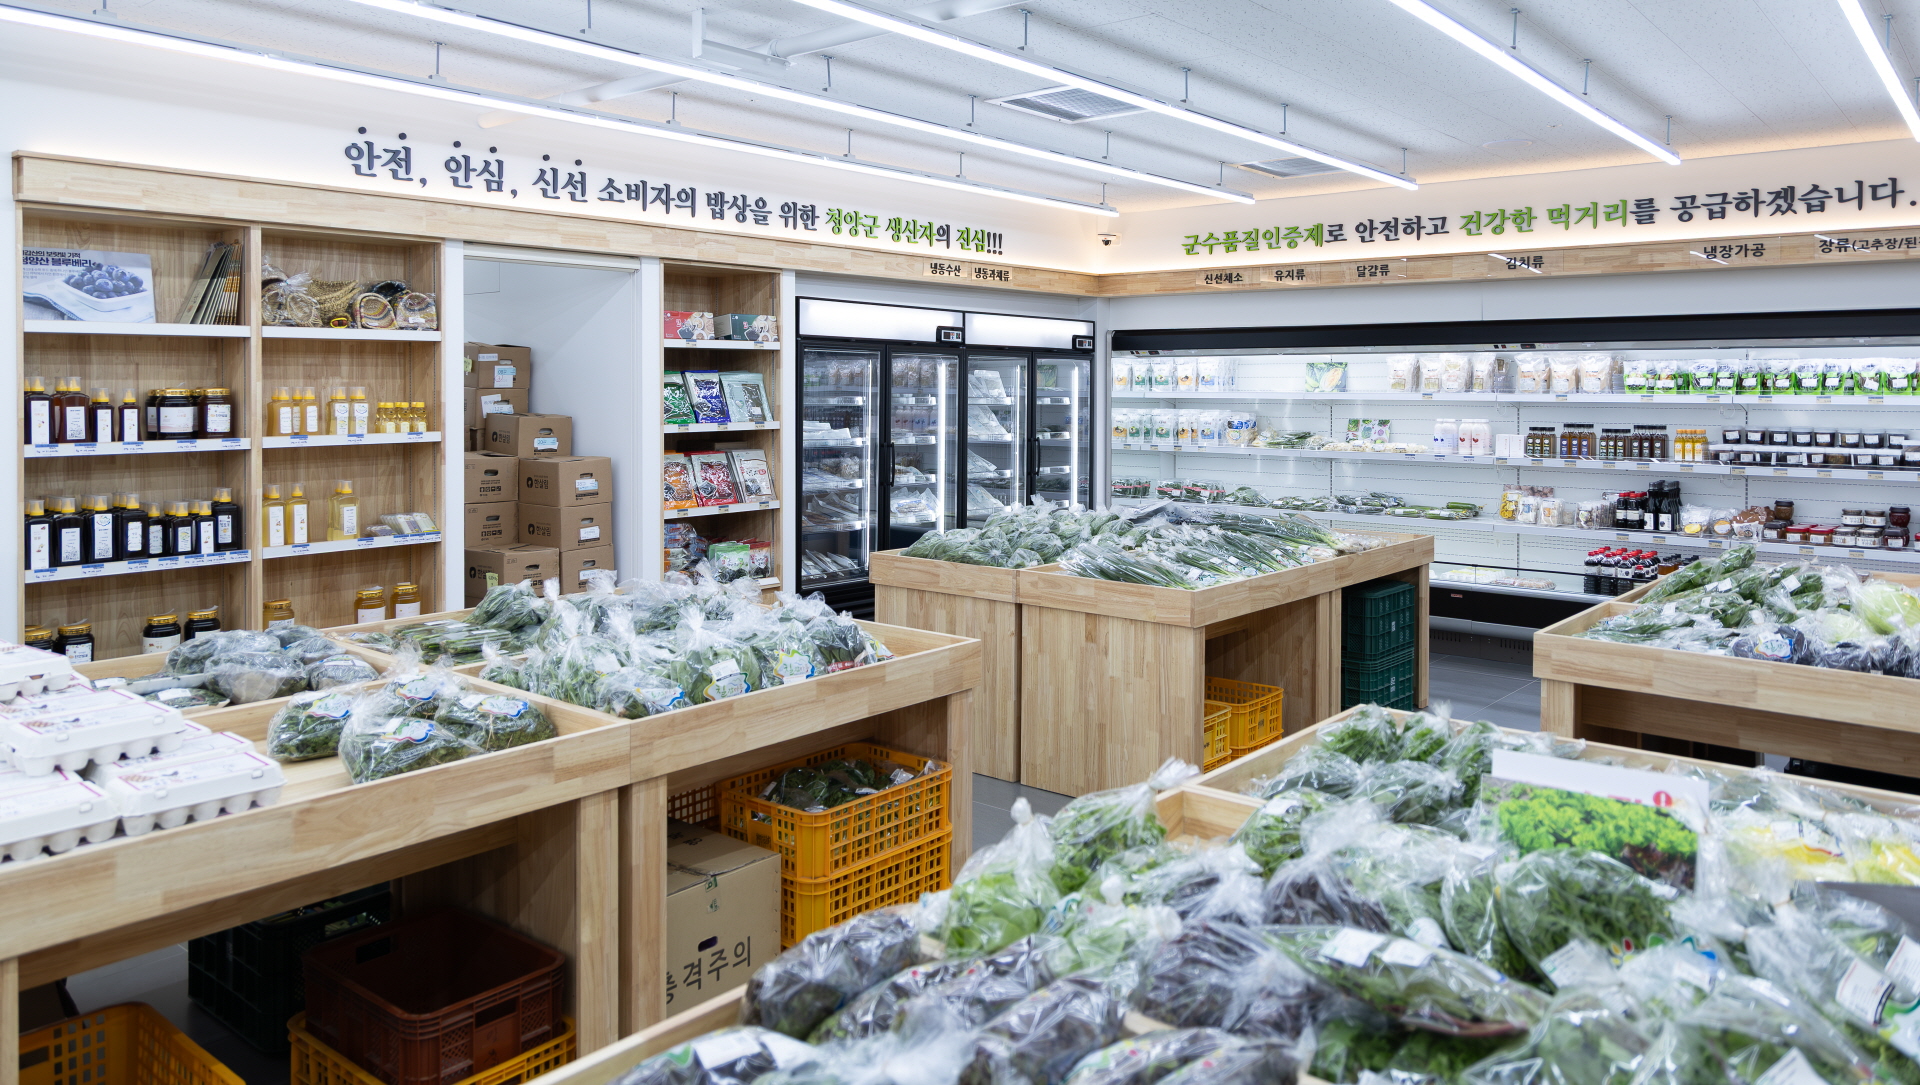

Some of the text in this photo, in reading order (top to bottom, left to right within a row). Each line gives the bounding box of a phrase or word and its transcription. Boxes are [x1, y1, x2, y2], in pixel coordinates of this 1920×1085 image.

[344, 138, 1004, 256] 안전, 안심, 신선 소비자의 밥상을 위한 청양군 생산자의 진심!!!
[1181, 177, 1918, 256] 군수품질인증제로 안전하고 건강한 먹거리를 공급하겠습니다.
[1703, 242, 1766, 260] 냉장가공
[1819, 236, 1920, 254] 장류(고추장/된
[51, 257, 93, 268] 블루베리
[930, 262, 961, 277] 냉동수산
[1505, 255, 1545, 270] 김치류
[974, 267, 1010, 282] 냉동과채류
[1274, 268, 1306, 281] 유지류
[1356, 263, 1390, 278] 달걀류
[1204, 272, 1244, 285] 신선채소
